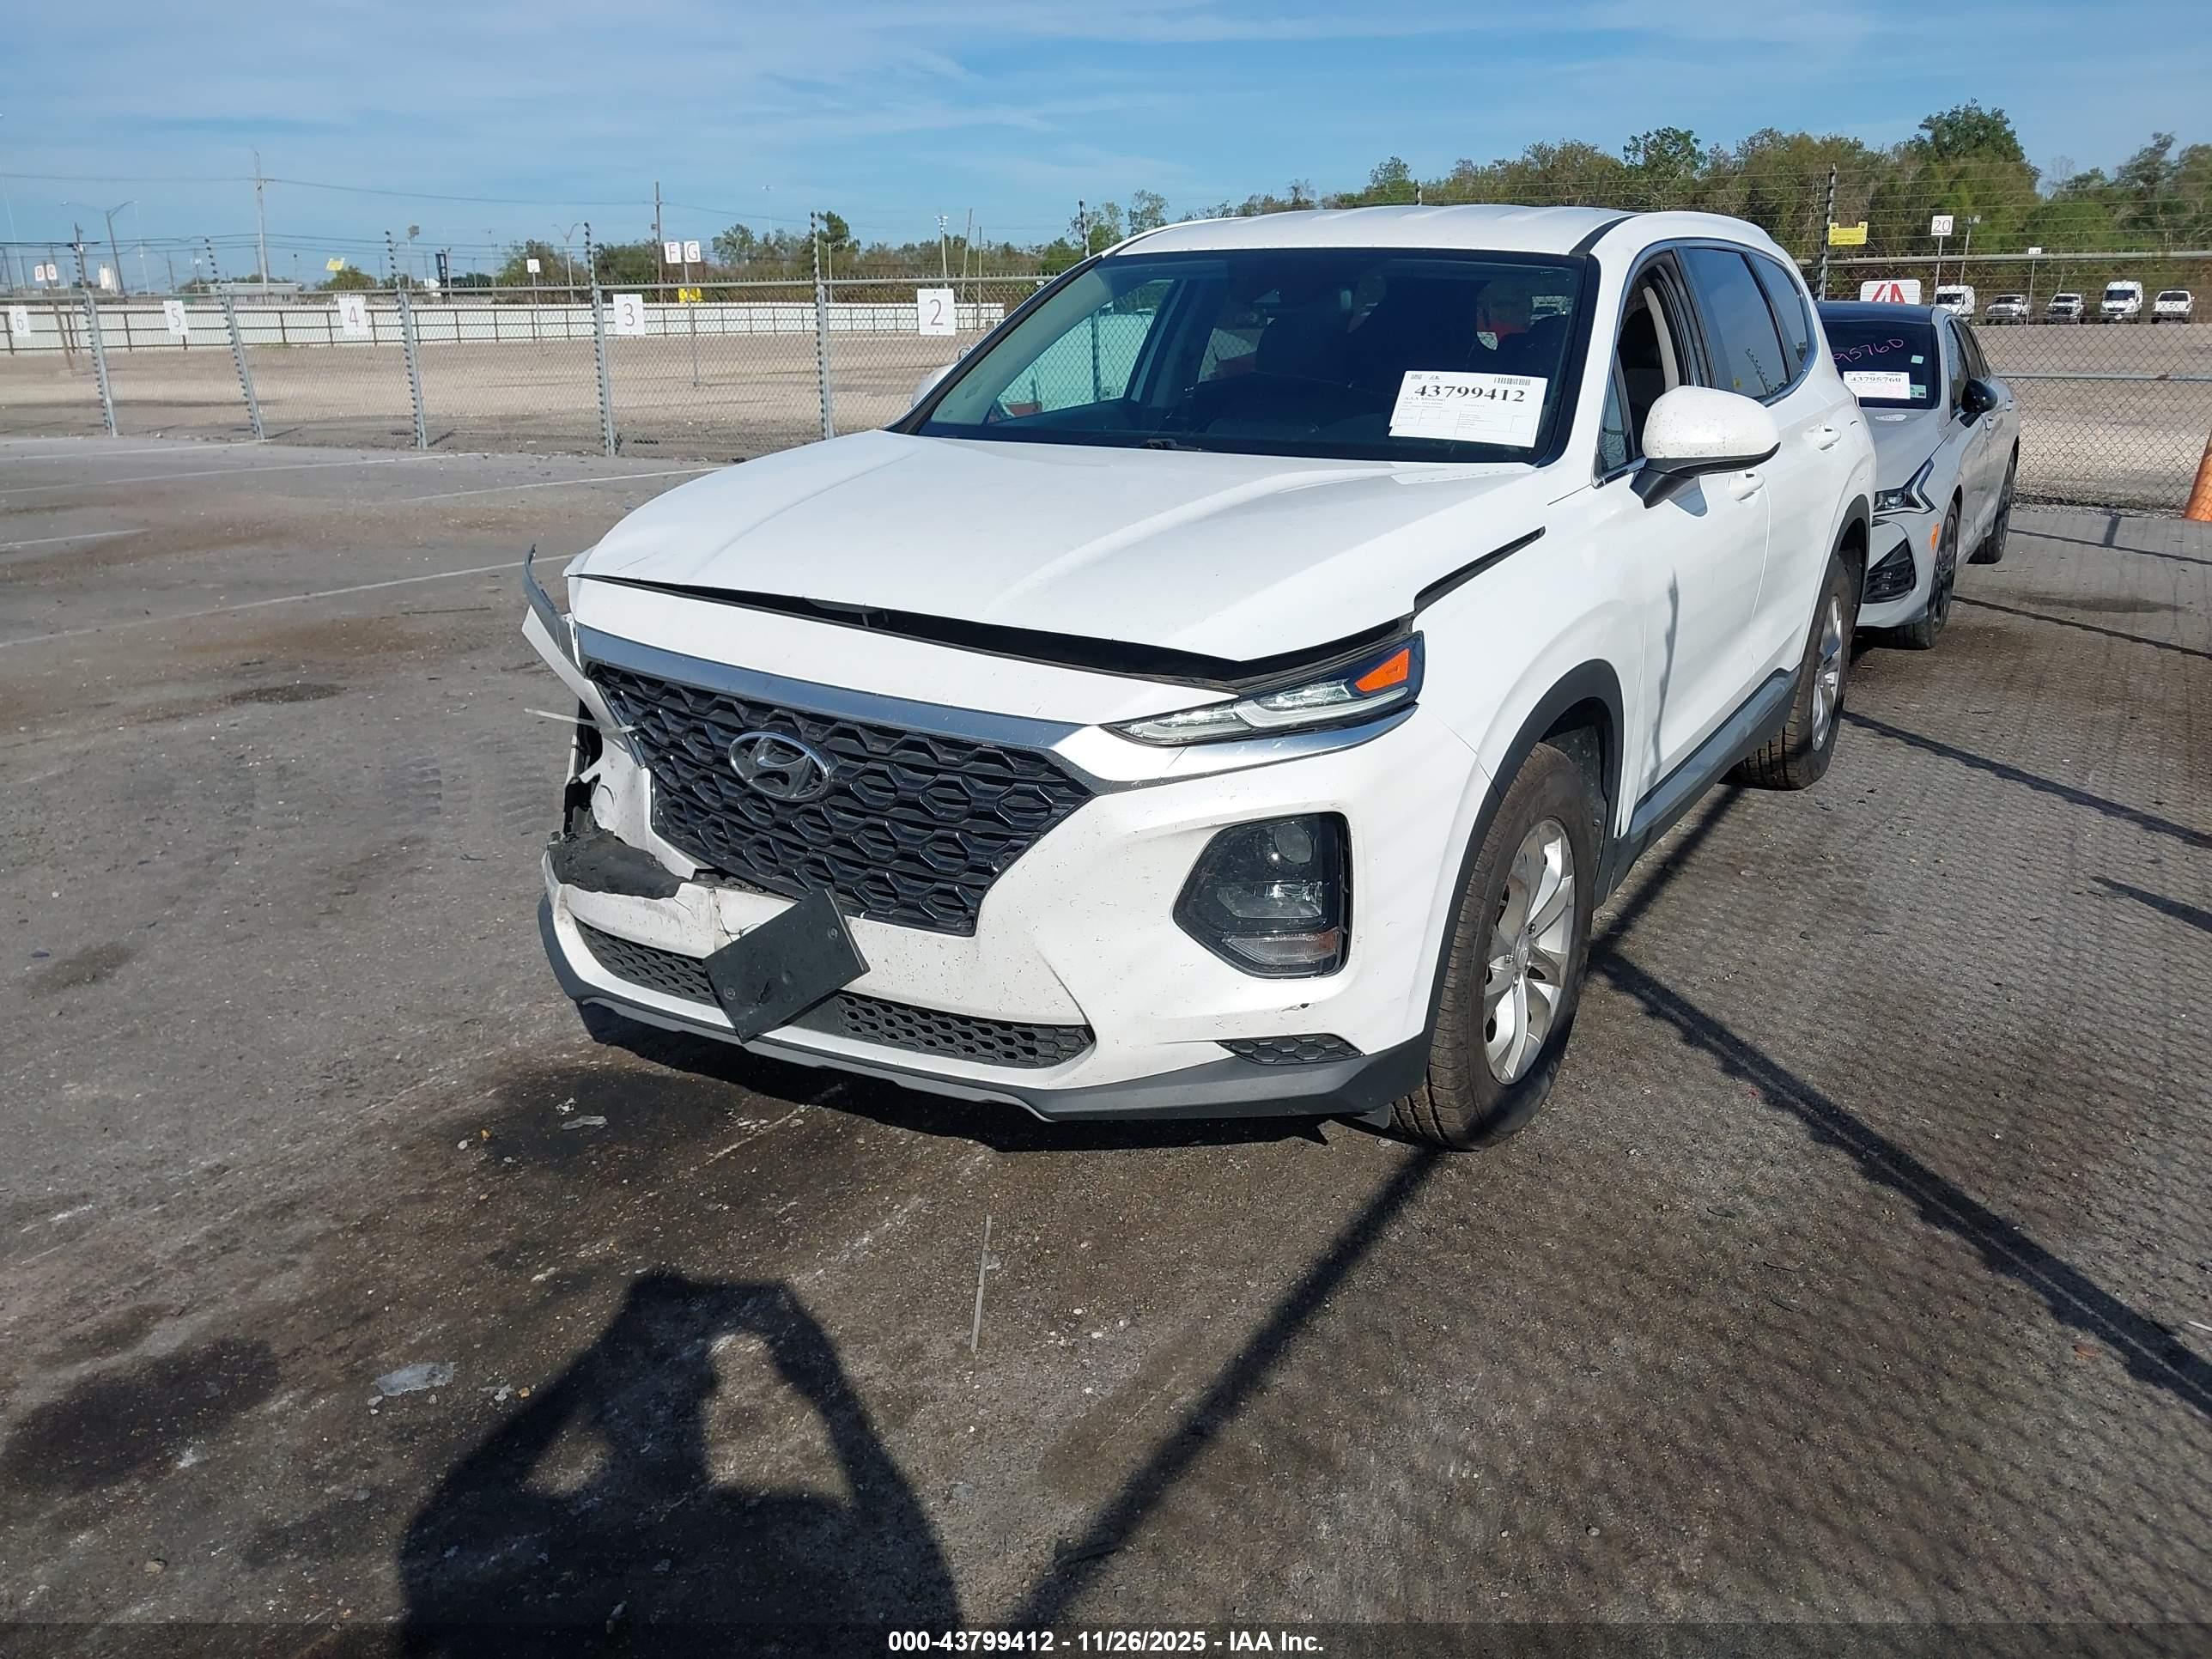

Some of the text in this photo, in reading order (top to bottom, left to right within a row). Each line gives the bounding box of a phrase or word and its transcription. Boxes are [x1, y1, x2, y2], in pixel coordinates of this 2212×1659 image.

[1933, 219, 1951, 232] 20
[668, 244, 676, 261] F
[687, 242, 698, 260] G
[171, 307, 180, 327] 5
[349, 306, 359, 327] 4
[623, 302, 635, 326] 3
[929, 298, 944, 325] 2
[15, 312, 24, 331] 6
[1414, 385, 1525, 402] 43799412
